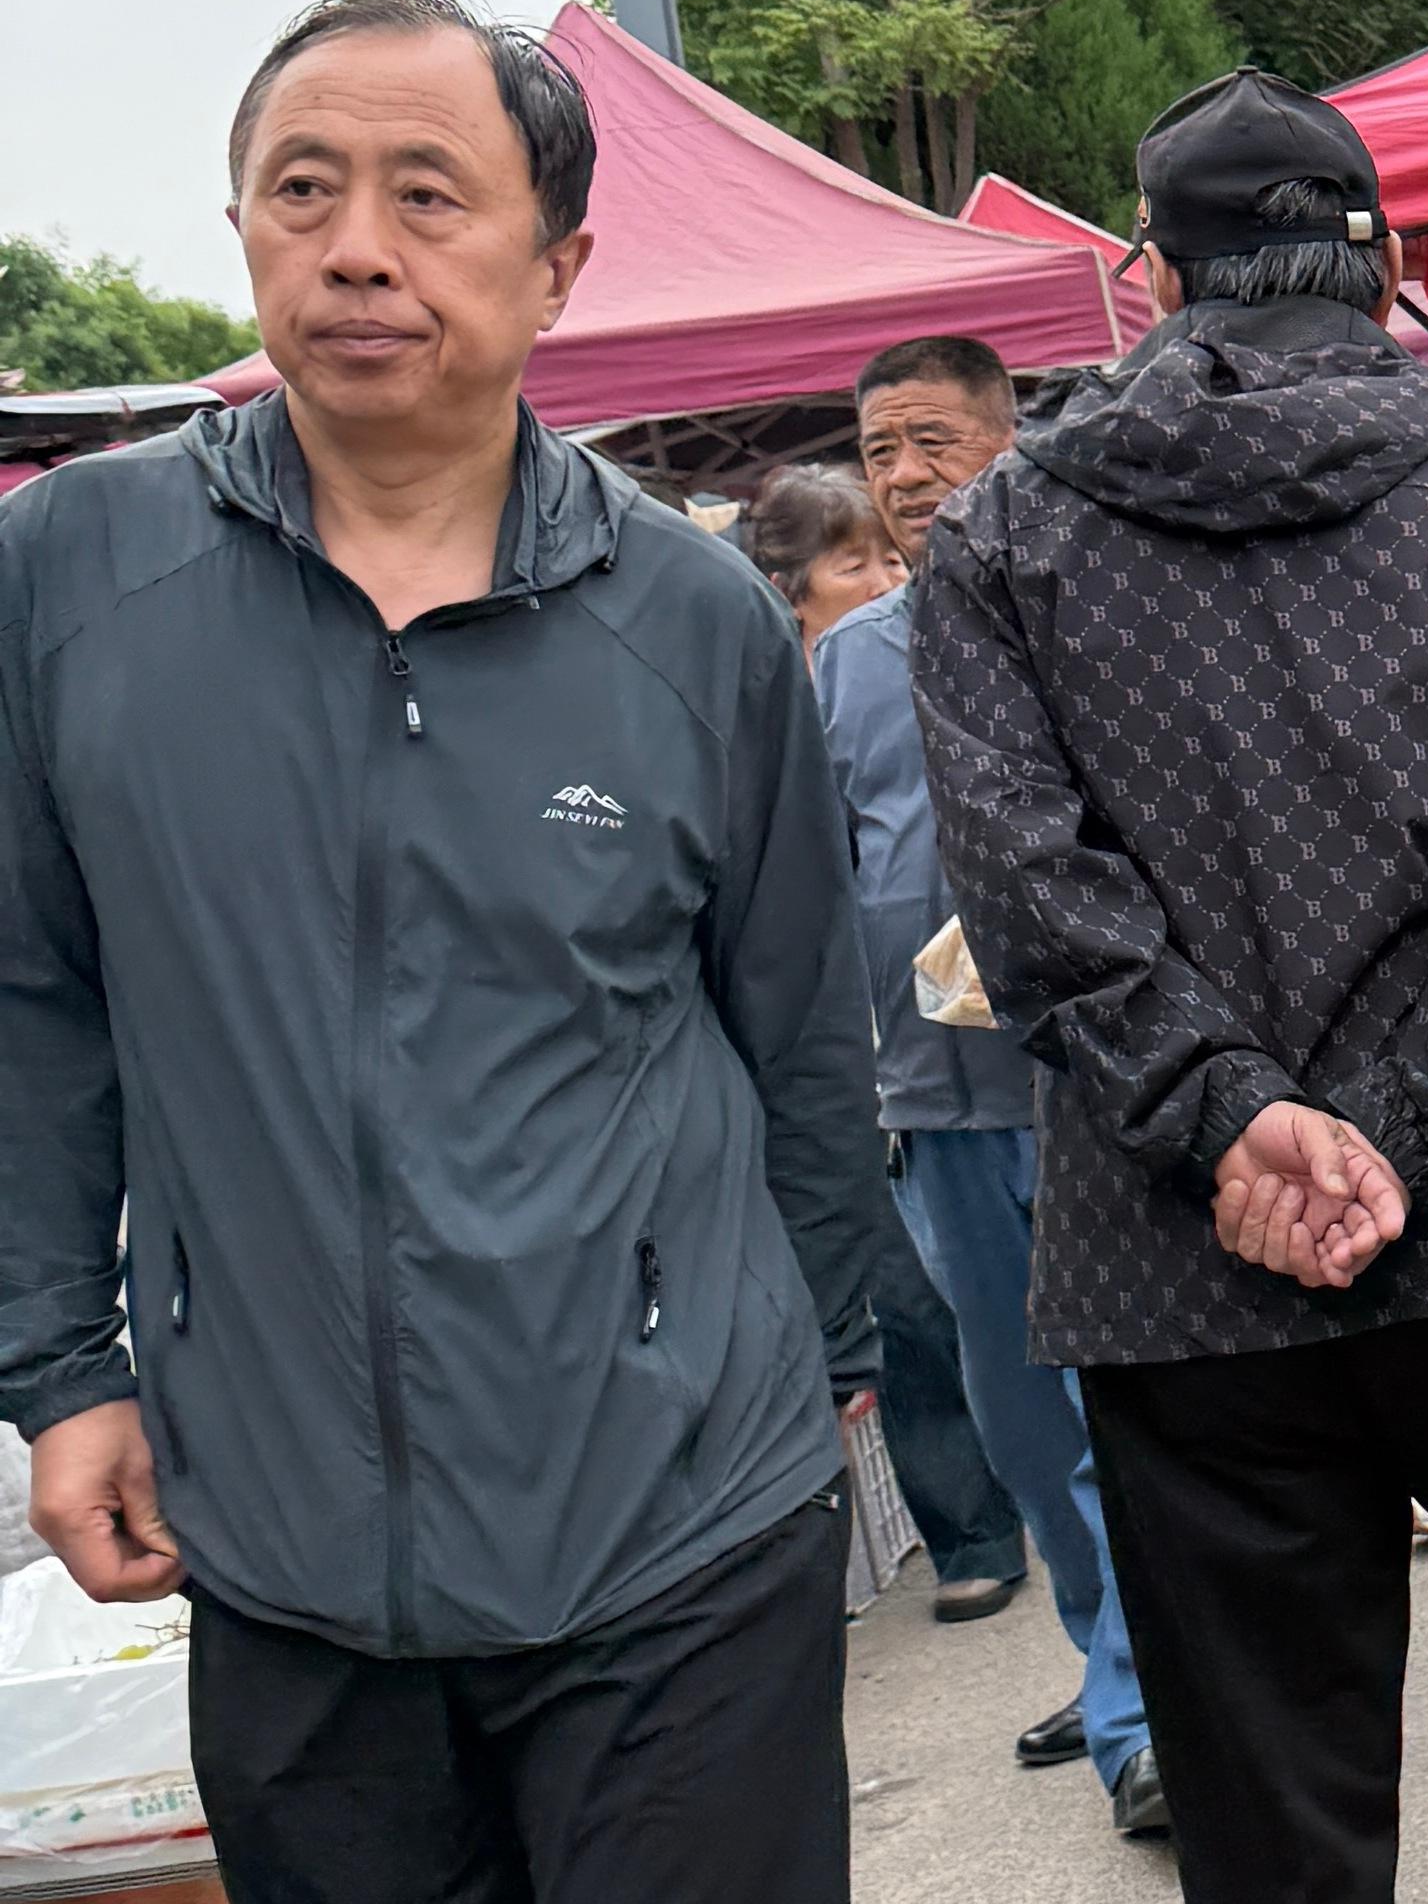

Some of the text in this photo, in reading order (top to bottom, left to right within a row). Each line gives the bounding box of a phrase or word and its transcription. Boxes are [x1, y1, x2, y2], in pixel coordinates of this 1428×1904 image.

[1401, 521, 1418, 536] B
[1136, 539, 1153, 557] B
[1085, 550, 1102, 568] B
[1271, 558, 1287, 574] B
[1324, 556, 1340, 573] B
[1377, 550, 1393, 566] B
[1165, 564, 1182, 582] B
[1219, 563, 1236, 580] B
[1061, 578, 1078, 596] B
[1112, 572, 1128, 590] B
[1353, 580, 1369, 596] B
[1405, 573, 1421, 590] B
[1195, 590, 1212, 607] B
[1248, 587, 1262, 605] B
[1300, 584, 1316, 601] B
[1090, 606, 1106, 622] B
[1142, 596, 1159, 614] B
[1381, 603, 1398, 621] B
[1224, 619, 1240, 636] B
[1274, 612, 1291, 629] B
[1328, 610, 1344, 627] B
[1119, 629, 1135, 647] B
[1171, 622, 1188, 639] B
[1410, 627, 1425, 645] B
[1303, 637, 1320, 654] B
[1357, 634, 1374, 652] B
[1201, 646, 1217, 664] B
[1254, 644, 1271, 662] B
[1096, 661, 1113, 679] B
[1150, 654, 1165, 672] B
[1383, 658, 1400, 674] B
[1283, 669, 1296, 687] B
[1331, 664, 1348, 682] B
[1178, 679, 1194, 697] B
[1230, 675, 1246, 692] B
[1127, 687, 1143, 705] B
[1307, 693, 1324, 711] B
[1359, 688, 1375, 705] B
[1412, 684, 1426, 703] B
[1074, 695, 1090, 714] B
[1207, 704, 1223, 720] B
[1259, 702, 1275, 719] B
[1103, 719, 1120, 738] B
[1155, 712, 1171, 729] B
[1335, 720, 1352, 737] B
[1387, 713, 1401, 731] B
[1236, 731, 1252, 749] B
[1288, 727, 1304, 745] B
[1133, 745, 1150, 764] B
[1184, 736, 1201, 755] B
[1364, 743, 1381, 760] B
[1215, 762, 1230, 778] B
[1265, 758, 1282, 776] B
[1163, 769, 1179, 787] B
[1343, 777, 1359, 795] B
[1393, 770, 1409, 788] B
[1112, 778, 1128, 797] B
[1294, 785, 1311, 803] B
[1241, 788, 1258, 806] B
[1140, 803, 1157, 822] B
[1323, 810, 1340, 828] B
[1372, 802, 1388, 818] B
[1271, 815, 1287, 833] B
[1171, 828, 1187, 846] B
[1351, 835, 1368, 853] B
[1247, 847, 1263, 865] B
[1300, 842, 1316, 860] B
[1329, 867, 1345, 884] B
[1379, 859, 1396, 877] B
[1276, 873, 1293, 891] B
[1079, 886, 1096, 904] B
[1179, 886, 1196, 904] B
[1356, 892, 1373, 910] B
[1408, 884, 1423, 901] B
[1305, 899, 1321, 918] B
[1210, 912, 1227, 930] B
[1281, 931, 1297, 949] B
[1334, 924, 1349, 942] B
[1310, 957, 1326, 975] B
[1219, 970, 1235, 988] B
[1286, 989, 1302, 1007] B
